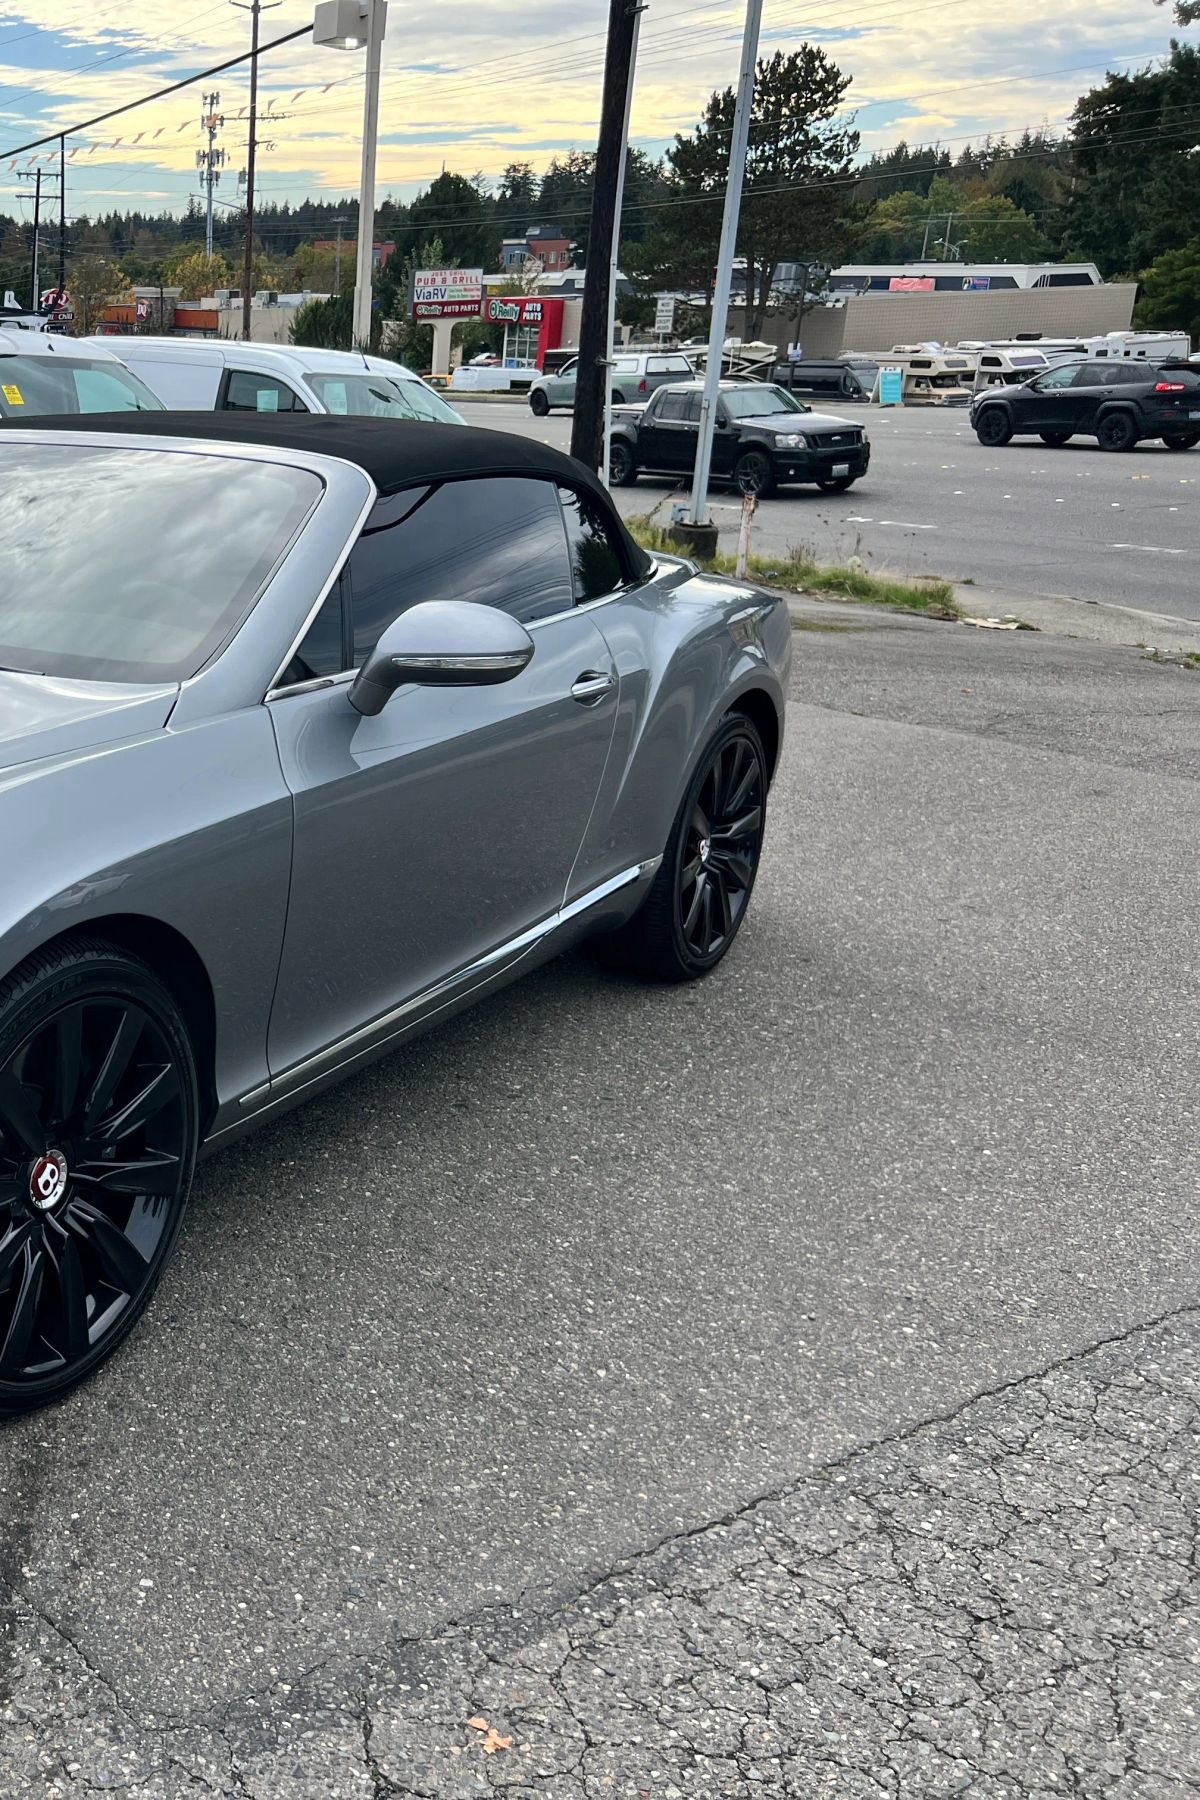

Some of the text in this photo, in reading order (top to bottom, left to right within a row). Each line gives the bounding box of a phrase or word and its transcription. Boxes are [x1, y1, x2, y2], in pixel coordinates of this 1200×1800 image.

[416, 277, 436, 286] PUB
[452, 275, 480, 284] GRILL
[415, 287, 447, 300] ViaRV
[443, 305, 459, 313] AUTO
[460, 304, 479, 312] PARTS
[525, 303, 542, 312] AUTO
[522, 311, 542, 321] PARTS
[37, 1162, 59, 1196] B
